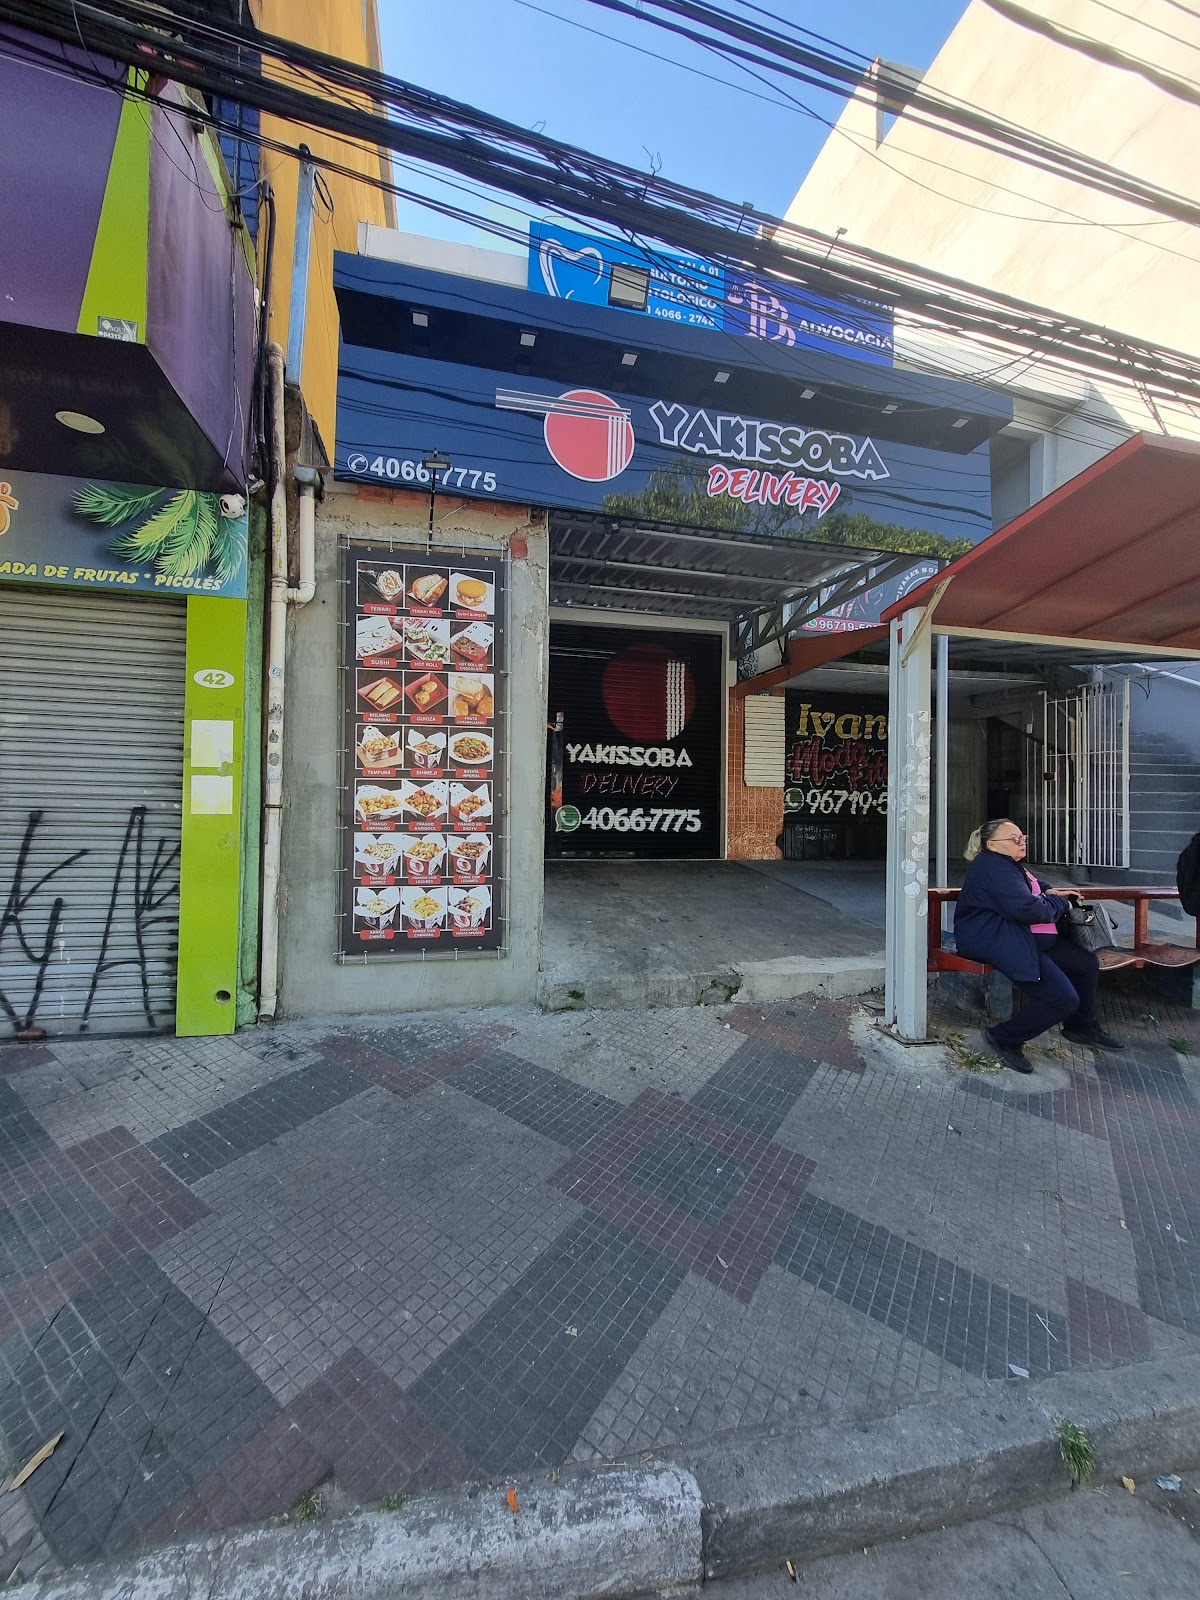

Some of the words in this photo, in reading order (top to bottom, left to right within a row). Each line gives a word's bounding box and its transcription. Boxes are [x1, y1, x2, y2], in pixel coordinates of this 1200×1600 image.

[709, 267, 719, 276] 01
[654, 308, 682, 320] 4066
[688, 314, 715, 326] 2748
[798, 320, 894, 350] ADVOCACIA
[648, 400, 890, 481] YAKISSOBA
[370, 456, 496, 492] 4066-7775
[707, 464, 841, 519] DELIVERY
[0, 561, 38, 576] ADA
[44, 565, 70, 578] DE
[73, 567, 140, 584] FRUTAS
[154, 574, 224, 591] PICOLÉS
[202, 672, 226, 686] 42
[796, 703, 889, 740] Ivan
[565, 742, 693, 768] YAKISSOBA
[582, 772, 679, 798] DELIVERY
[806, 789, 888, 814] 96719-5
[582, 806, 702, 832] 4066-7775
